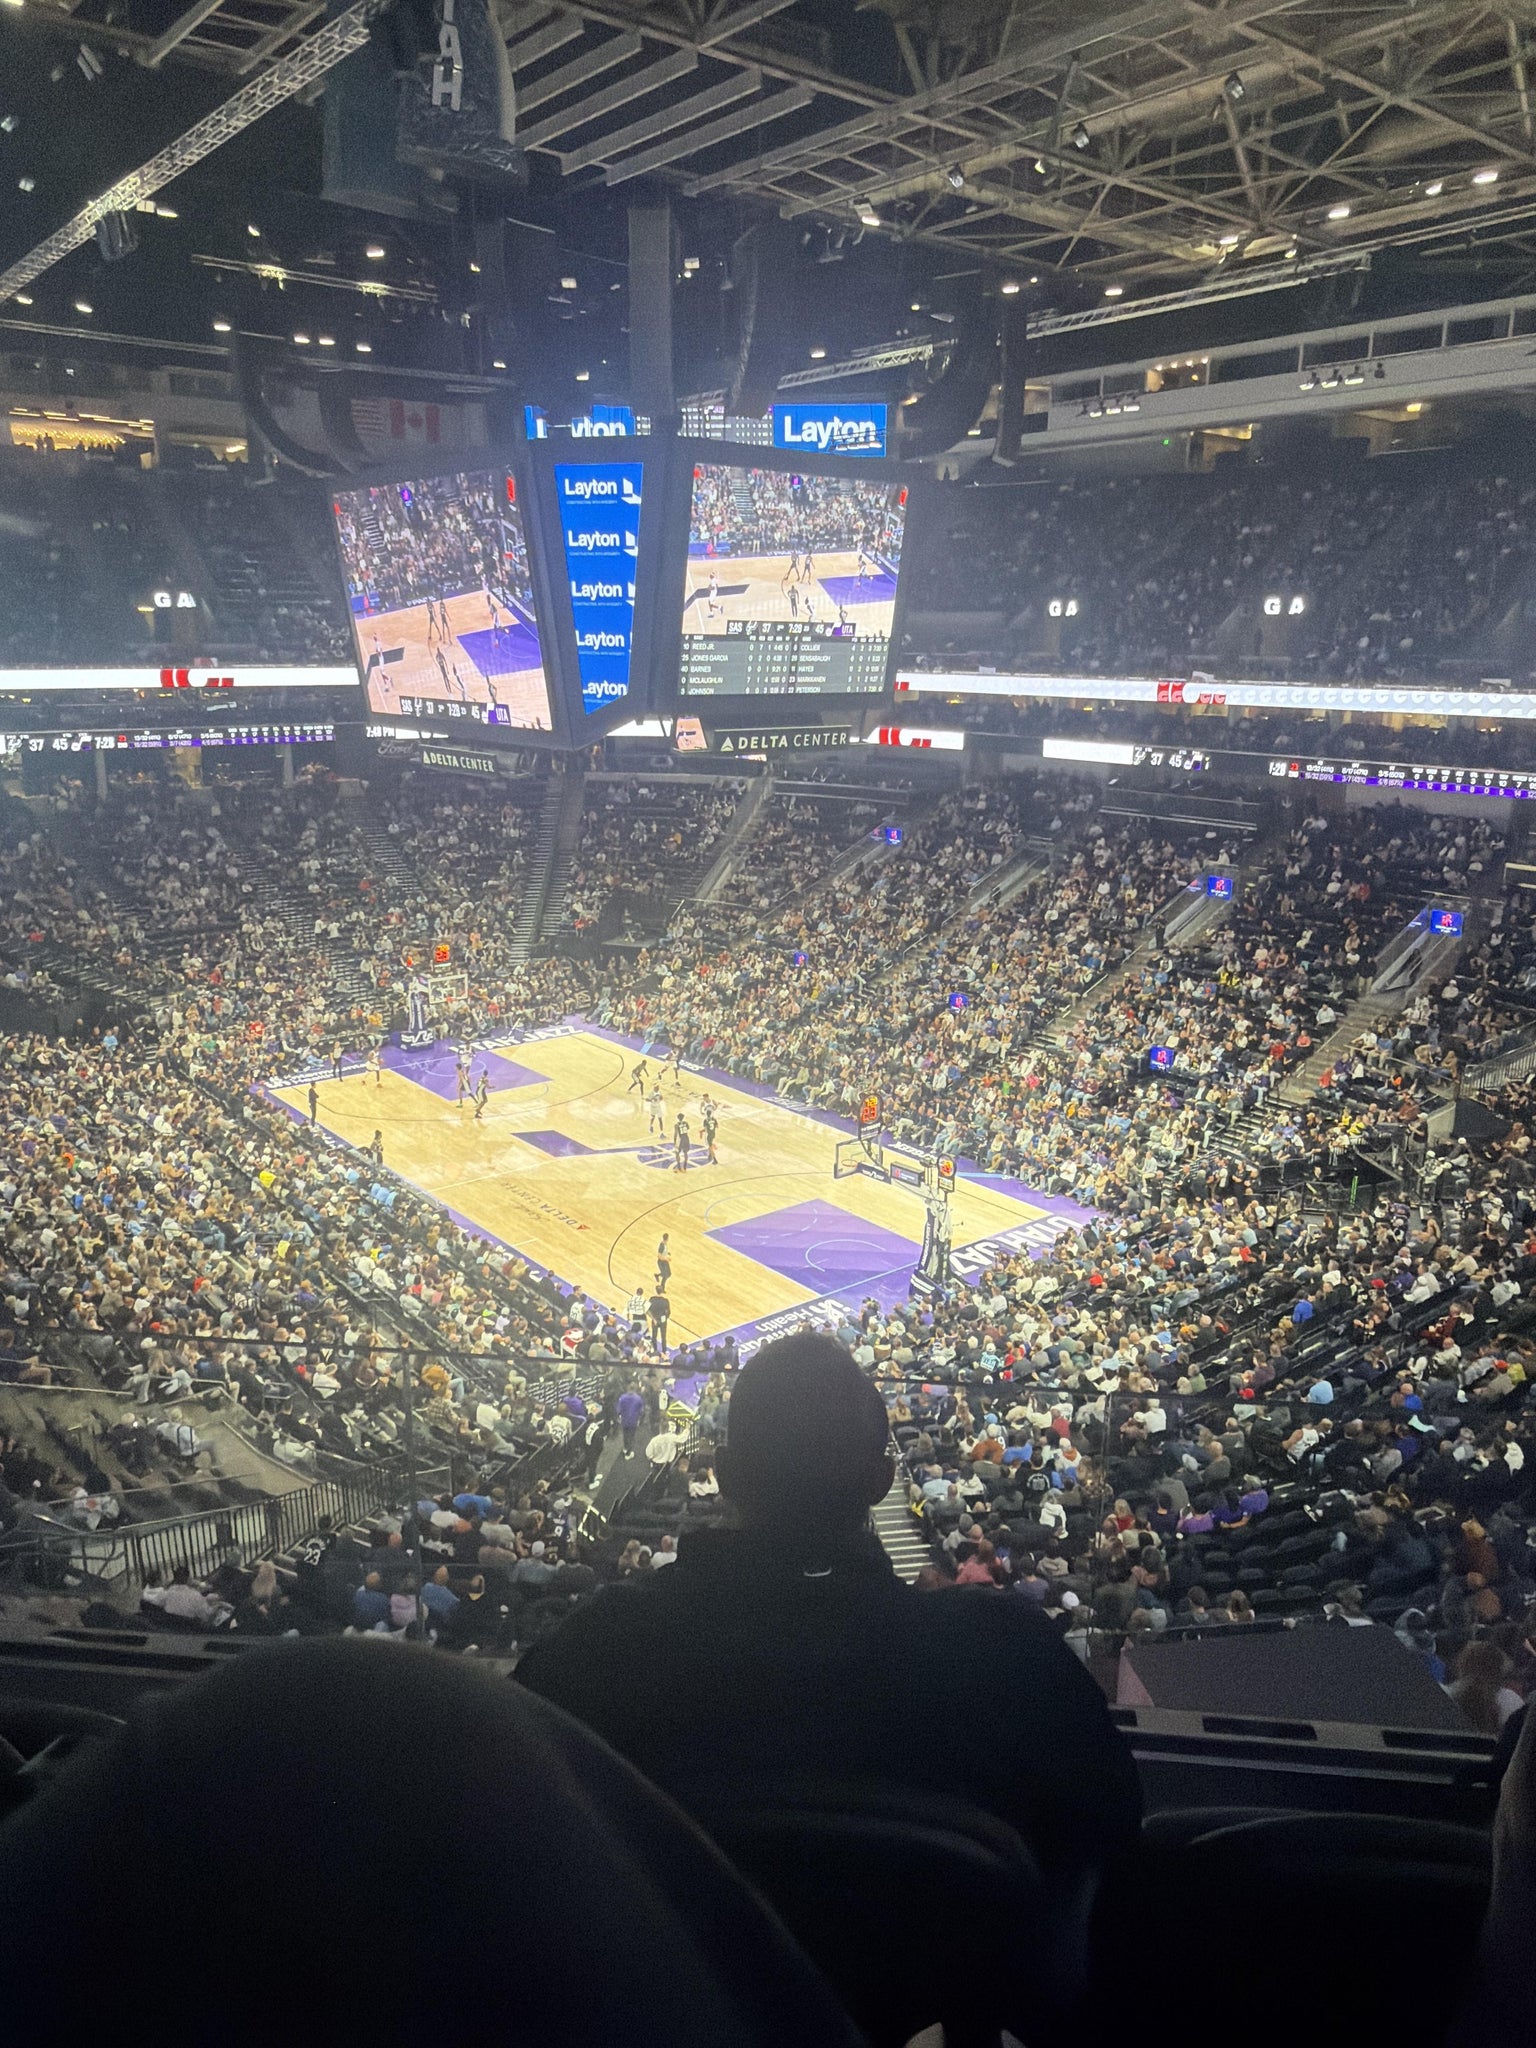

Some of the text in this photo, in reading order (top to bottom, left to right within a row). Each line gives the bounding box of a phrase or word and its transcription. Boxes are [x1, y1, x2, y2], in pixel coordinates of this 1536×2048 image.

[785, 416, 876, 448] Layton
[564, 478, 618, 499] Layton
[568, 530, 620, 551] Layton
[571, 580, 622, 601] Layton
[729, 623, 742, 632] SAS
[762, 623, 771, 632] 37
[815, 624, 824, 633] 45
[842, 625, 853, 634] UTA
[575, 630, 625, 650] Layton
[401, 700, 412, 713] SAS
[471, 705, 480, 720] 45
[496, 707, 508, 722] UTA
[29, 736, 114, 751] 37 45 7:28
[377, 741, 413, 755] Ford
[738, 733, 847, 750] DELTA CENTER
[429, 752, 495, 773] DELTA CENTER
[1150, 752, 1163, 766] 37
[1168, 754, 1182, 768] 45
[523, 1025, 583, 1042] JAZZ
[540, 1204, 578, 1225] DELTA
[995, 1216, 1084, 1252] UTAH
[755, 1309, 813, 1332] Health
[304, 1548, 320, 1566] 23
